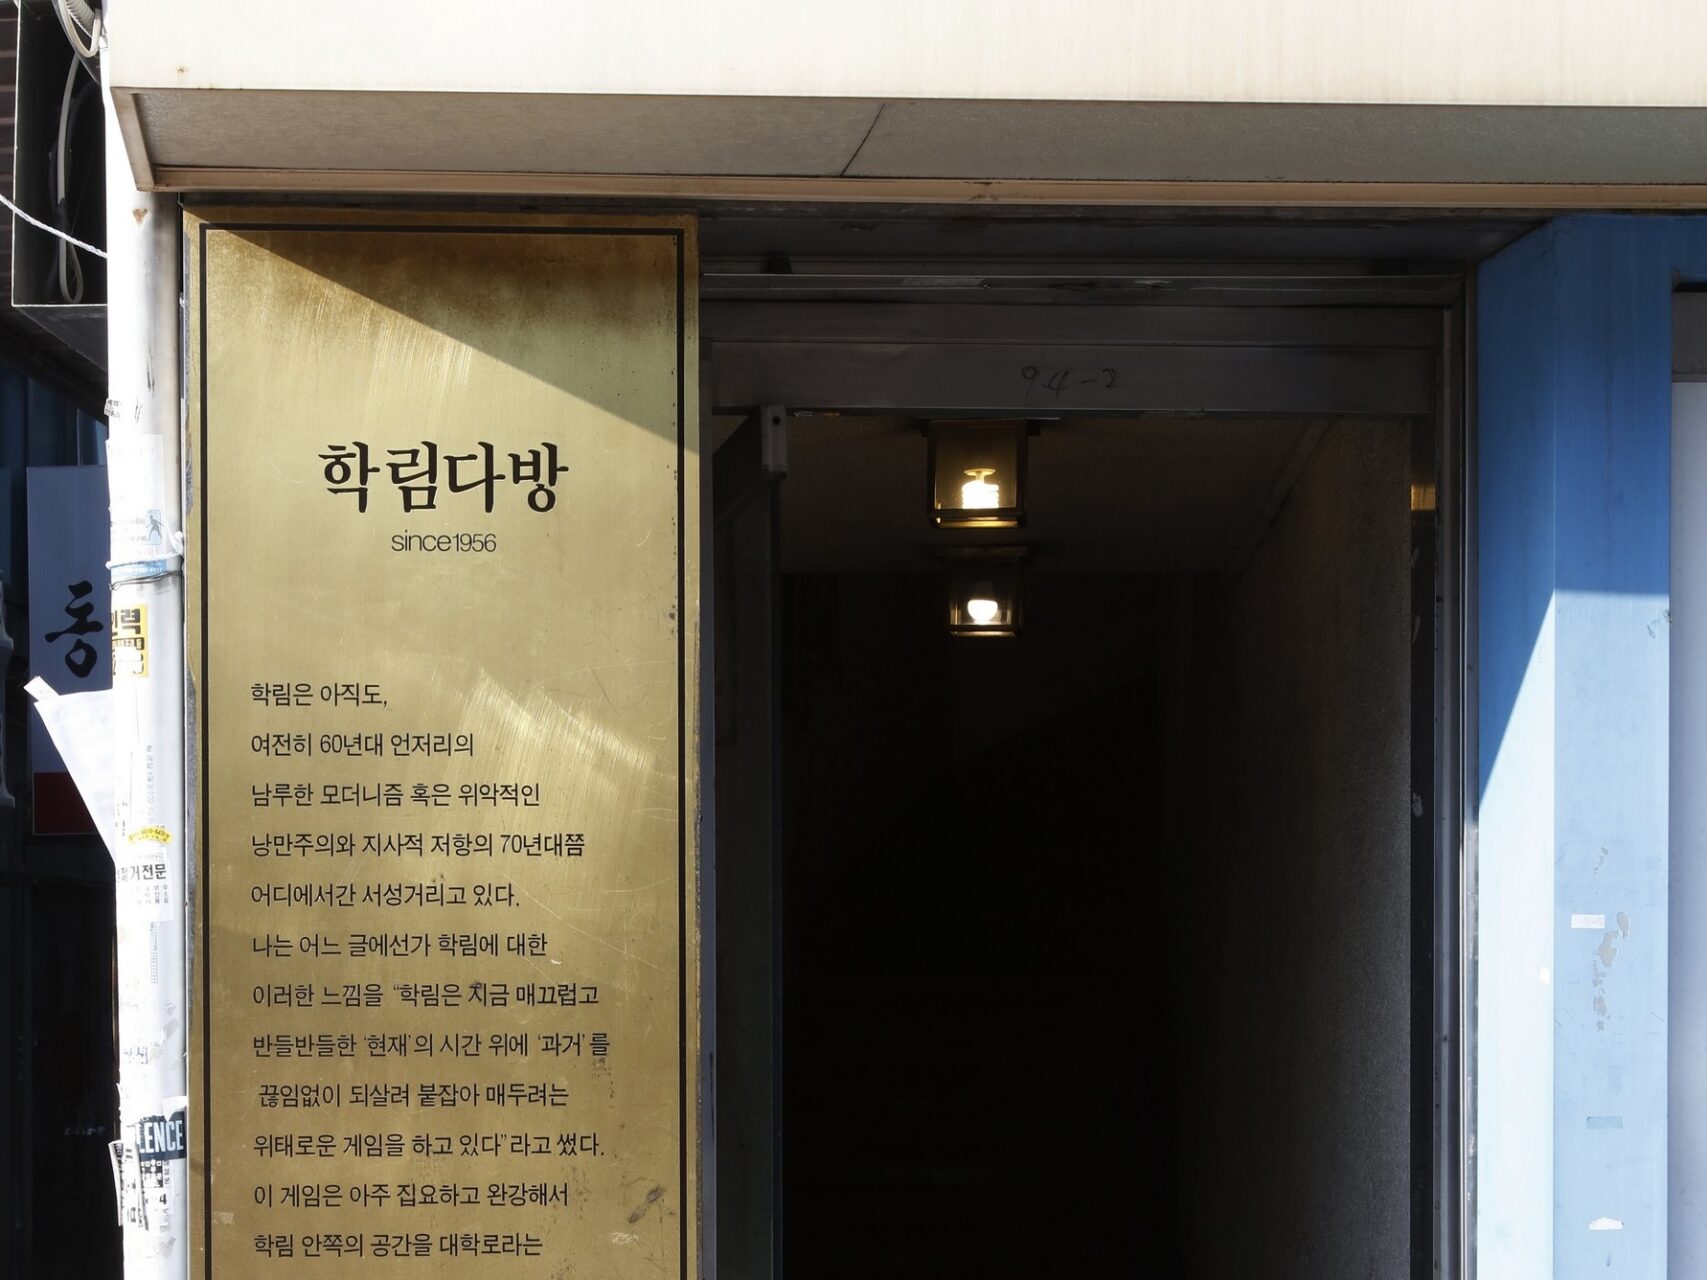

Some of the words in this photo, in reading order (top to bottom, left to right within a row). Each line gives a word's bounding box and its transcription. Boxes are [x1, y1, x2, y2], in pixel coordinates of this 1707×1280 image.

[317, 440, 570, 514] 학림다방
[391, 529, 497, 553] since1956
[250, 682, 314, 707] 학림은
[320, 682, 388, 708] 아직도,
[251, 732, 312, 757] 여전히
[319, 732, 383, 757] 60년대
[390, 732, 474, 758] 언저리의
[251, 782, 315, 808] 남루한
[319, 782, 404, 808] 모더니즘
[409, 782, 452, 808] 혹은
[457, 782, 540, 808] 위악적인
[252, 832, 357, 858] 낭만주의와
[361, 832, 423, 858] 지사적
[430, 832, 493, 857] 저항의
[499, 832, 586, 858] 70년대쯤
[251, 882, 357, 908] 어디에서간
[361, 882, 468, 908] 서성거리고
[472, 882, 520, 907] 있다.
[252, 933, 294, 958] 나는
[299, 933, 342, 958] 어느
[347, 932, 432, 958] 글에선가
[437, 932, 499, 958] 학림에
[506, 932, 549, 957] 대한
[253, 983, 315, 1008] 이러한
[320, 983, 384, 1008] 느낌을
[467, 981, 510, 1007] 지금
[515, 982, 600, 1007] 매끄럽고
[253, 1033, 358, 1058] 반들반들한
[439, 1032, 483, 1058] 시간
[488, 1032, 528, 1057] 위에
[258, 1083, 341, 1108] 끊임없이
[349, 1083, 409, 1108] 되살려
[417, 1082, 481, 1108] 붙잡아
[486, 1082, 570, 1107] 매두려는
[253, 1133, 337, 1158] 위태로운
[342, 1133, 406, 1158] 게임을
[411, 1132, 454, 1158] 하고
[556, 1132, 605, 1157] 썼다.
[254, 1183, 272, 1208] 이
[280, 1183, 344, 1208] 게임은
[349, 1183, 391, 1208] 아주
[396, 1182, 481, 1208] 집요하고
[486, 1182, 568, 1207] 완강해서
[253, 1233, 294, 1258] 학림
[301, 1233, 363, 1258] 안쪽의
[370, 1233, 433, 1258] 공간을
[439, 1232, 544, 1257] 대학로라는
